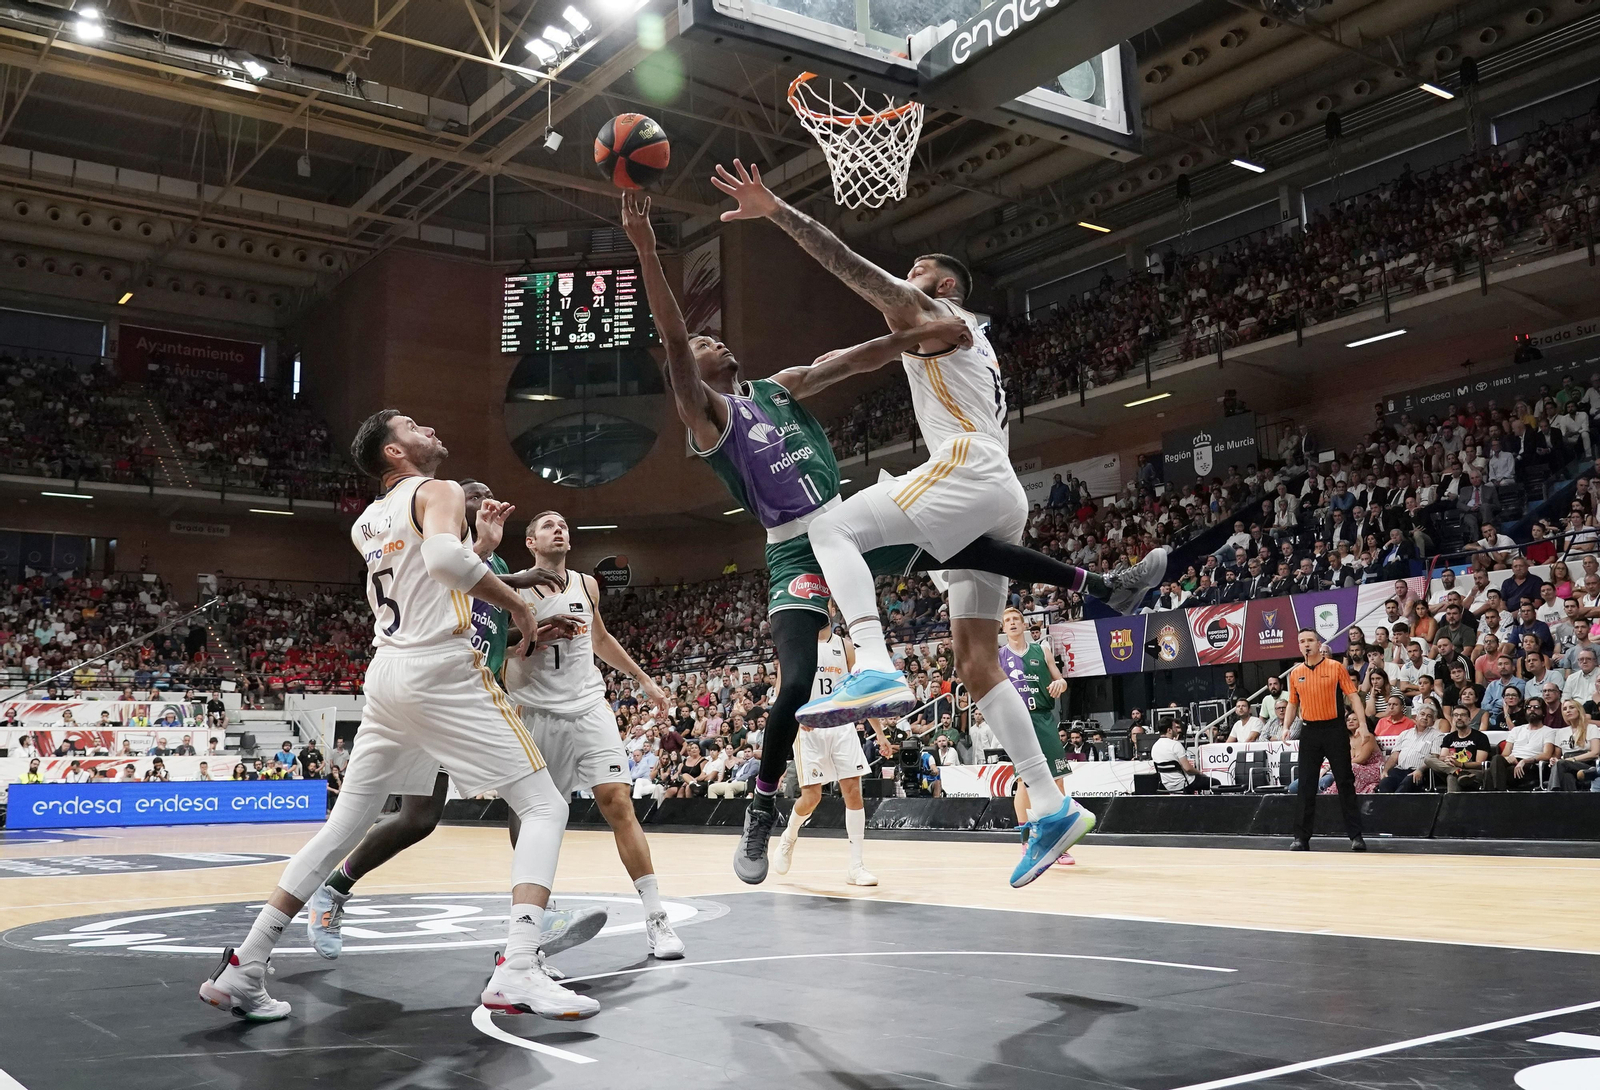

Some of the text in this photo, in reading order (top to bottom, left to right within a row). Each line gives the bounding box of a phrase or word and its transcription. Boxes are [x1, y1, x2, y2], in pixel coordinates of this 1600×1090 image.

[952, 0, 1059, 65] ende
[560, 297, 572, 310] 17
[593, 296, 605, 307] 21
[554, 326, 560, 336] 0
[578, 324, 588, 333] 2T
[1530, 324, 1597, 347] Grada Sur
[569, 332, 595, 343] 9:29
[1420, 391, 1450, 404] endesa
[1214, 437, 1255, 452] de Murcia
[770, 445, 814, 475] málaga
[1164, 450, 1191, 464] Región
[798, 473, 823, 505] 11
[372, 567, 401, 637] 5
[1258, 629, 1284, 640] UCAM
[552, 645, 560, 670] 1
[819, 678, 833, 695] 13
[1028, 697, 1037, 711] 9
[1209, 753, 1230, 764] acb
[32, 792, 310, 816] endesa endesa endesa
